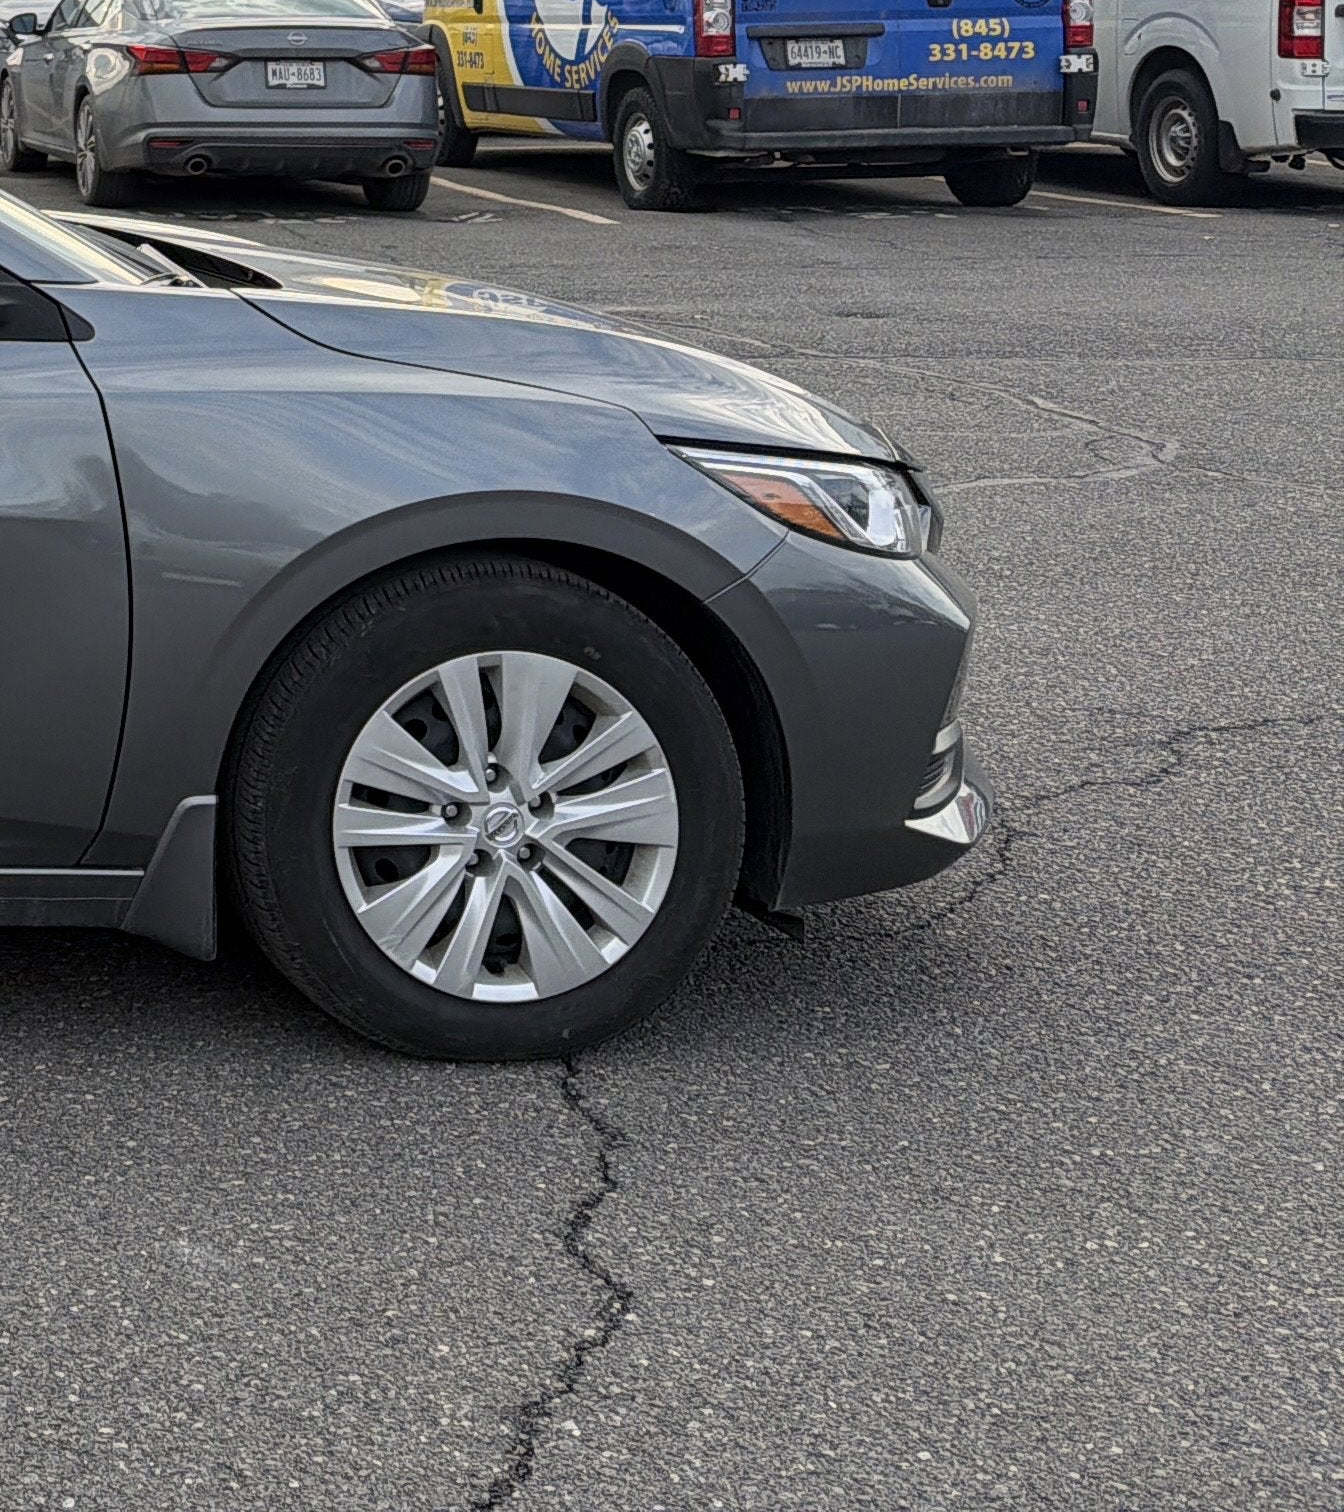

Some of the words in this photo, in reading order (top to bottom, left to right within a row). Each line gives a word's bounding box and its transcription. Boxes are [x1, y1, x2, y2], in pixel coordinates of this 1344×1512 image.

[952, 18, 1010, 39] (845)
[564, 10, 619, 89] SERVICES
[928, 41, 1036, 61] 331-8473
[786, 71, 1013, 94] www.JSPHomeServices.com
